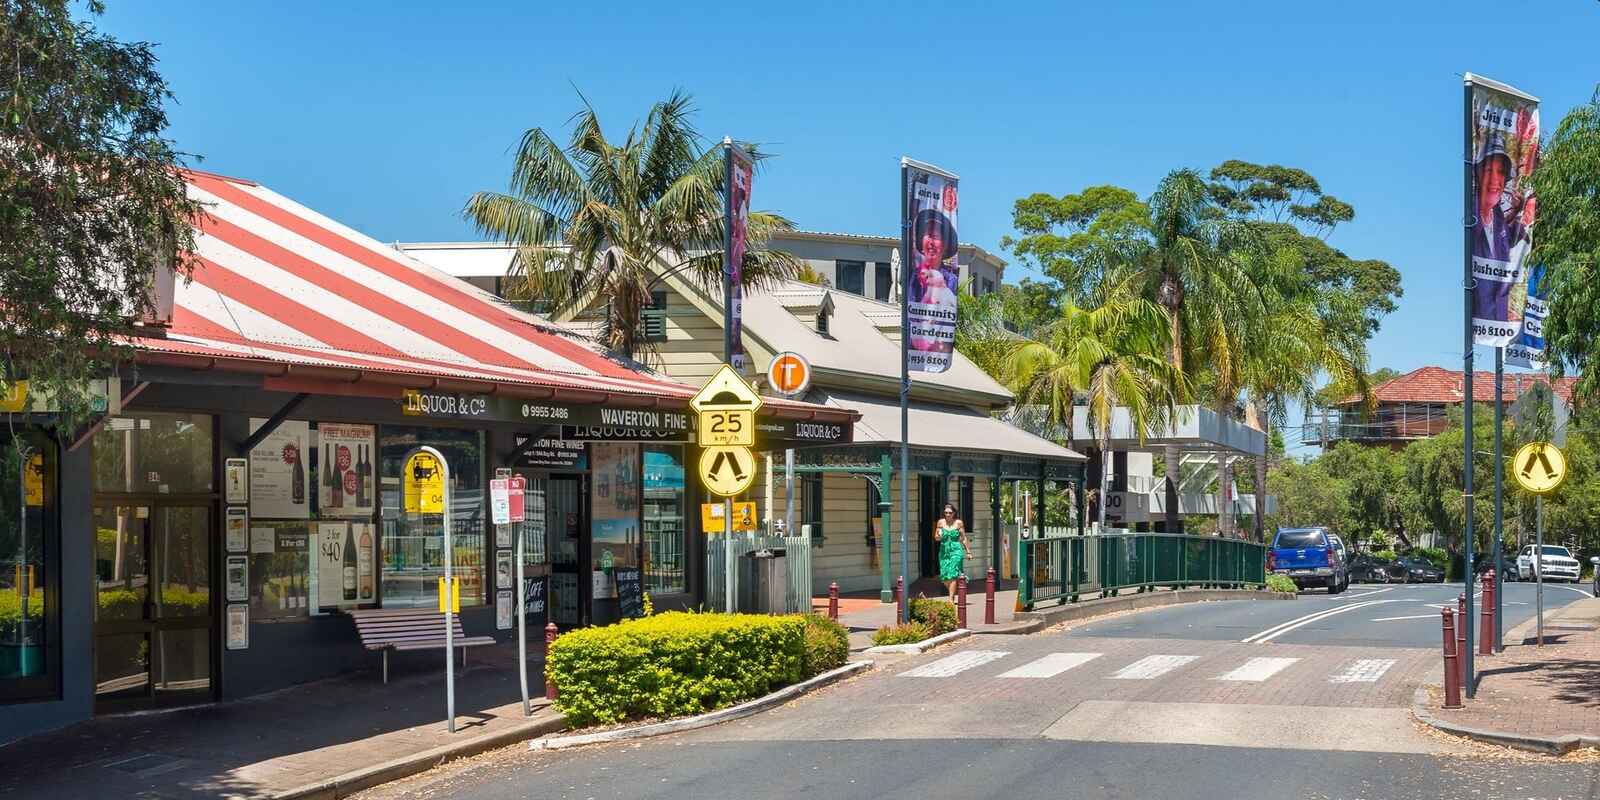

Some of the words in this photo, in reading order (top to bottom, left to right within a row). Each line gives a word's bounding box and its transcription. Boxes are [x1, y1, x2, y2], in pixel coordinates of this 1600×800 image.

[912, 327, 954, 338] Gardens
[1488, 326, 1515, 337] 8100
[780, 364, 797, 386] T
[408, 394, 456, 414] LIQUOR
[458, 398, 468, 415] &
[531, 405, 549, 418] 9955
[550, 407, 569, 419] 2486
[601, 408, 659, 427] WAVERTON
[664, 413, 686, 429] FINE
[711, 414, 742, 433] 25
[714, 435, 739, 443] km/h
[796, 424, 824, 438] LIQUOR
[825, 426, 831, 439] &
[321, 542, 341, 562] $40
